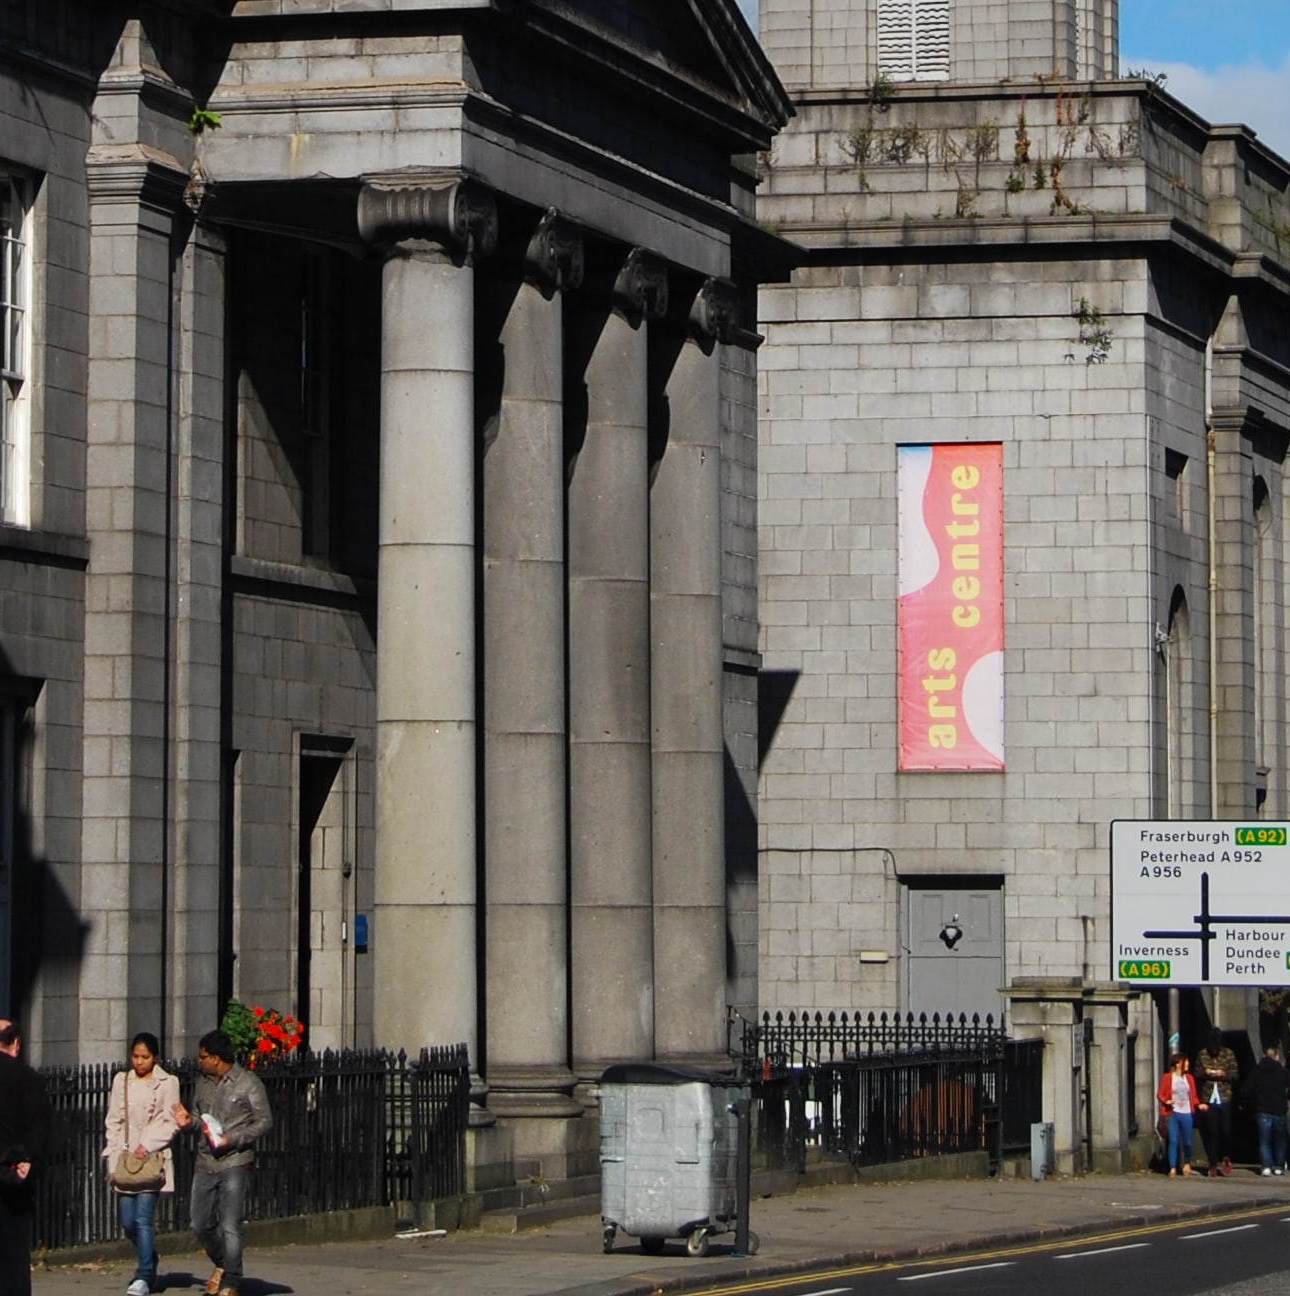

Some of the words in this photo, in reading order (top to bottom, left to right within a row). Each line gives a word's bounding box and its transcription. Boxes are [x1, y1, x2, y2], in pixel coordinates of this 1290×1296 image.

[945, 464, 981, 628] centre
[922, 647, 957, 750] arts
[1140, 830, 1230, 845] Fraserburgh
[1140, 851, 1215, 863] Peterhead
[1225, 929, 1285, 941] Harbour
[1119, 944, 1190, 956] Inverness
[1225, 946, 1281, 959] Dundee
[1225, 962, 1266, 974] Perth
